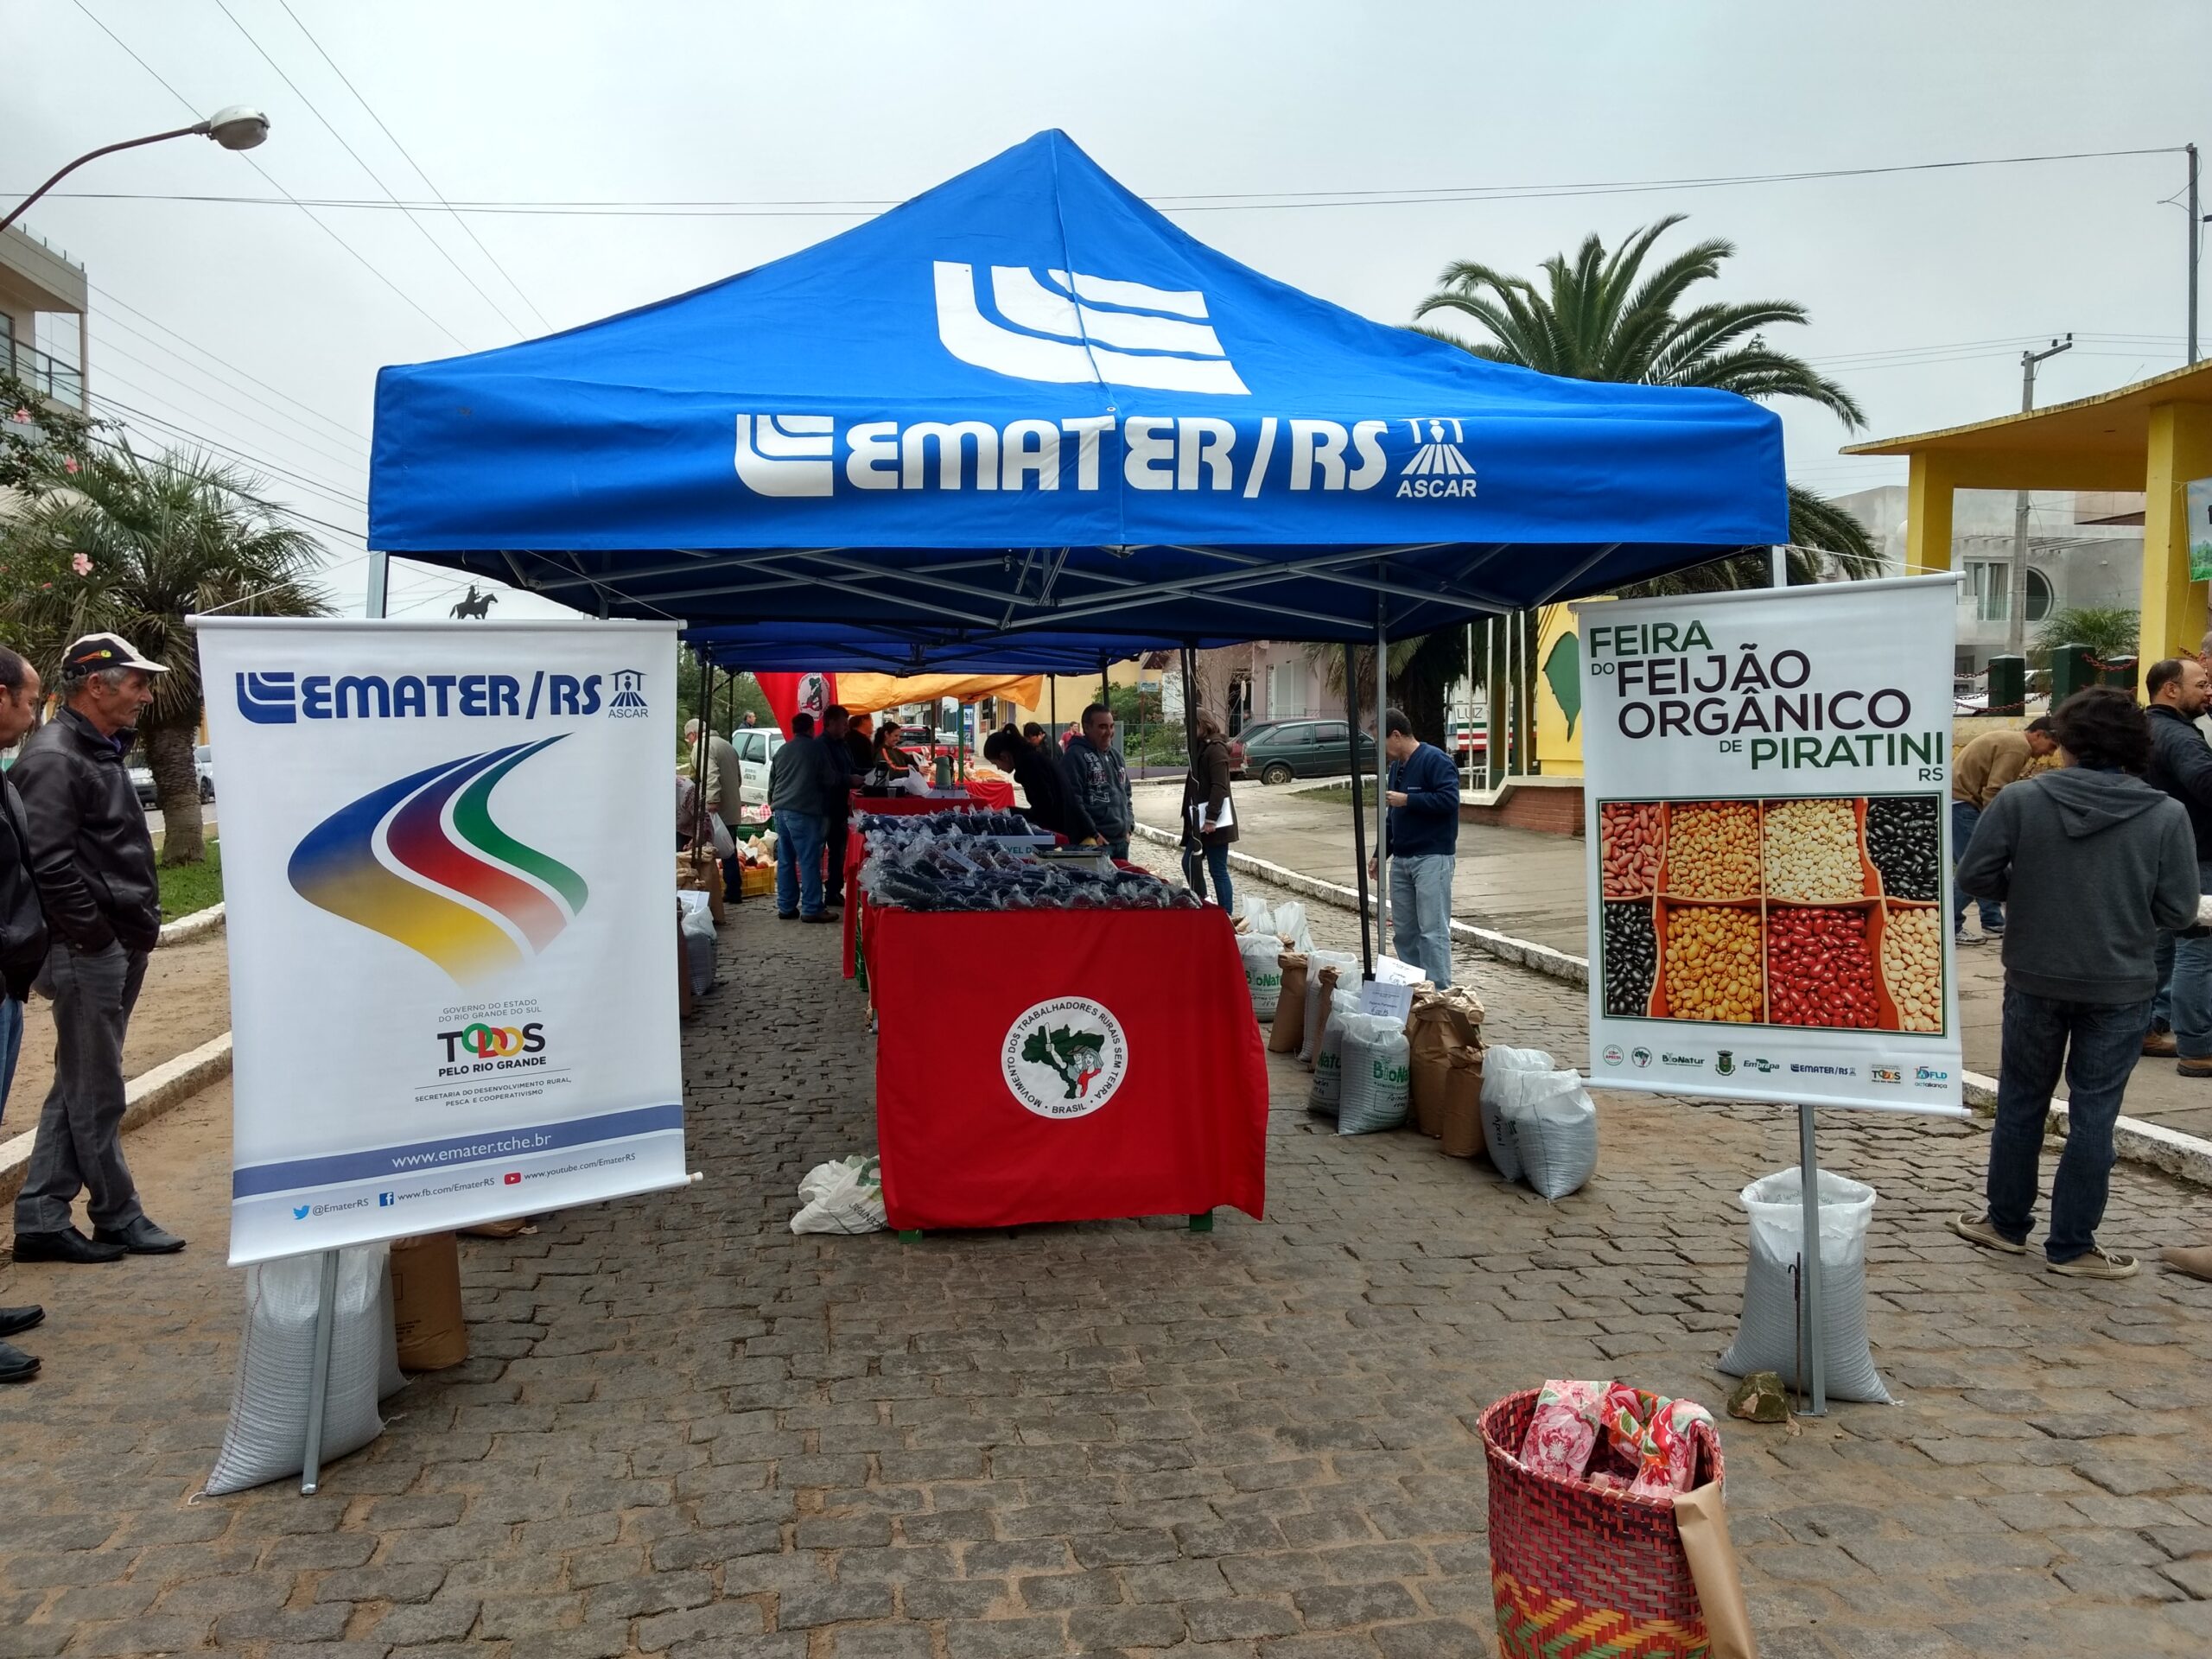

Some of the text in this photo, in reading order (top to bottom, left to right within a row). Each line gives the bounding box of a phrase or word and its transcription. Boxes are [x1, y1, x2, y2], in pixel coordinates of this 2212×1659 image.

[846, 415, 1389, 499] EMATER/RS
[1395, 479, 1478, 499] ASCAR
[1590, 620, 1713, 658] FEIRA
[1592, 643, 1811, 697] DO FEIJÃO
[301, 671, 602, 720] EMATER/RS
[608, 709, 649, 719] ASCAR
[1618, 686, 1911, 739] ORGÂNICO
[1719, 731, 1943, 770] DE PIRATINI
[1918, 767, 1944, 782] RS
[442, 1004, 486, 1014] GOVERNO
[504, 999, 537, 1008] ESTADO
[472, 1009, 508, 1019] GRANDE
[437, 1022, 546, 1063] TODOS
[1007, 1001, 1122, 1108] MOVIMENTO DOS TRABALHADORES RURAIS SEM TERRA
[1662, 1052, 1705, 1065] BioNatur
[1744, 1059, 1780, 1071] Embrapa
[438, 1056, 547, 1077] PELO RIO GRANDE
[1800, 1065, 1849, 1076] EMATER/RS
[415, 1090, 461, 1103] SECRETARIA
[474, 1080, 544, 1095] DESENVOLVIMENTO
[546, 1077, 572, 1085] RURAL,
[479, 1089, 543, 1103] COOPERATIVISMO
[1052, 1103, 1088, 1114] BRASIL
[391, 1133, 551, 1168] www.emater.tche.br
[312, 1198, 369, 1217] @EmaterRS
[397, 1177, 495, 1201] www.fb.com/EmaterRS
[524, 1153, 637, 1180] www.youtube.com/EmaterRS
